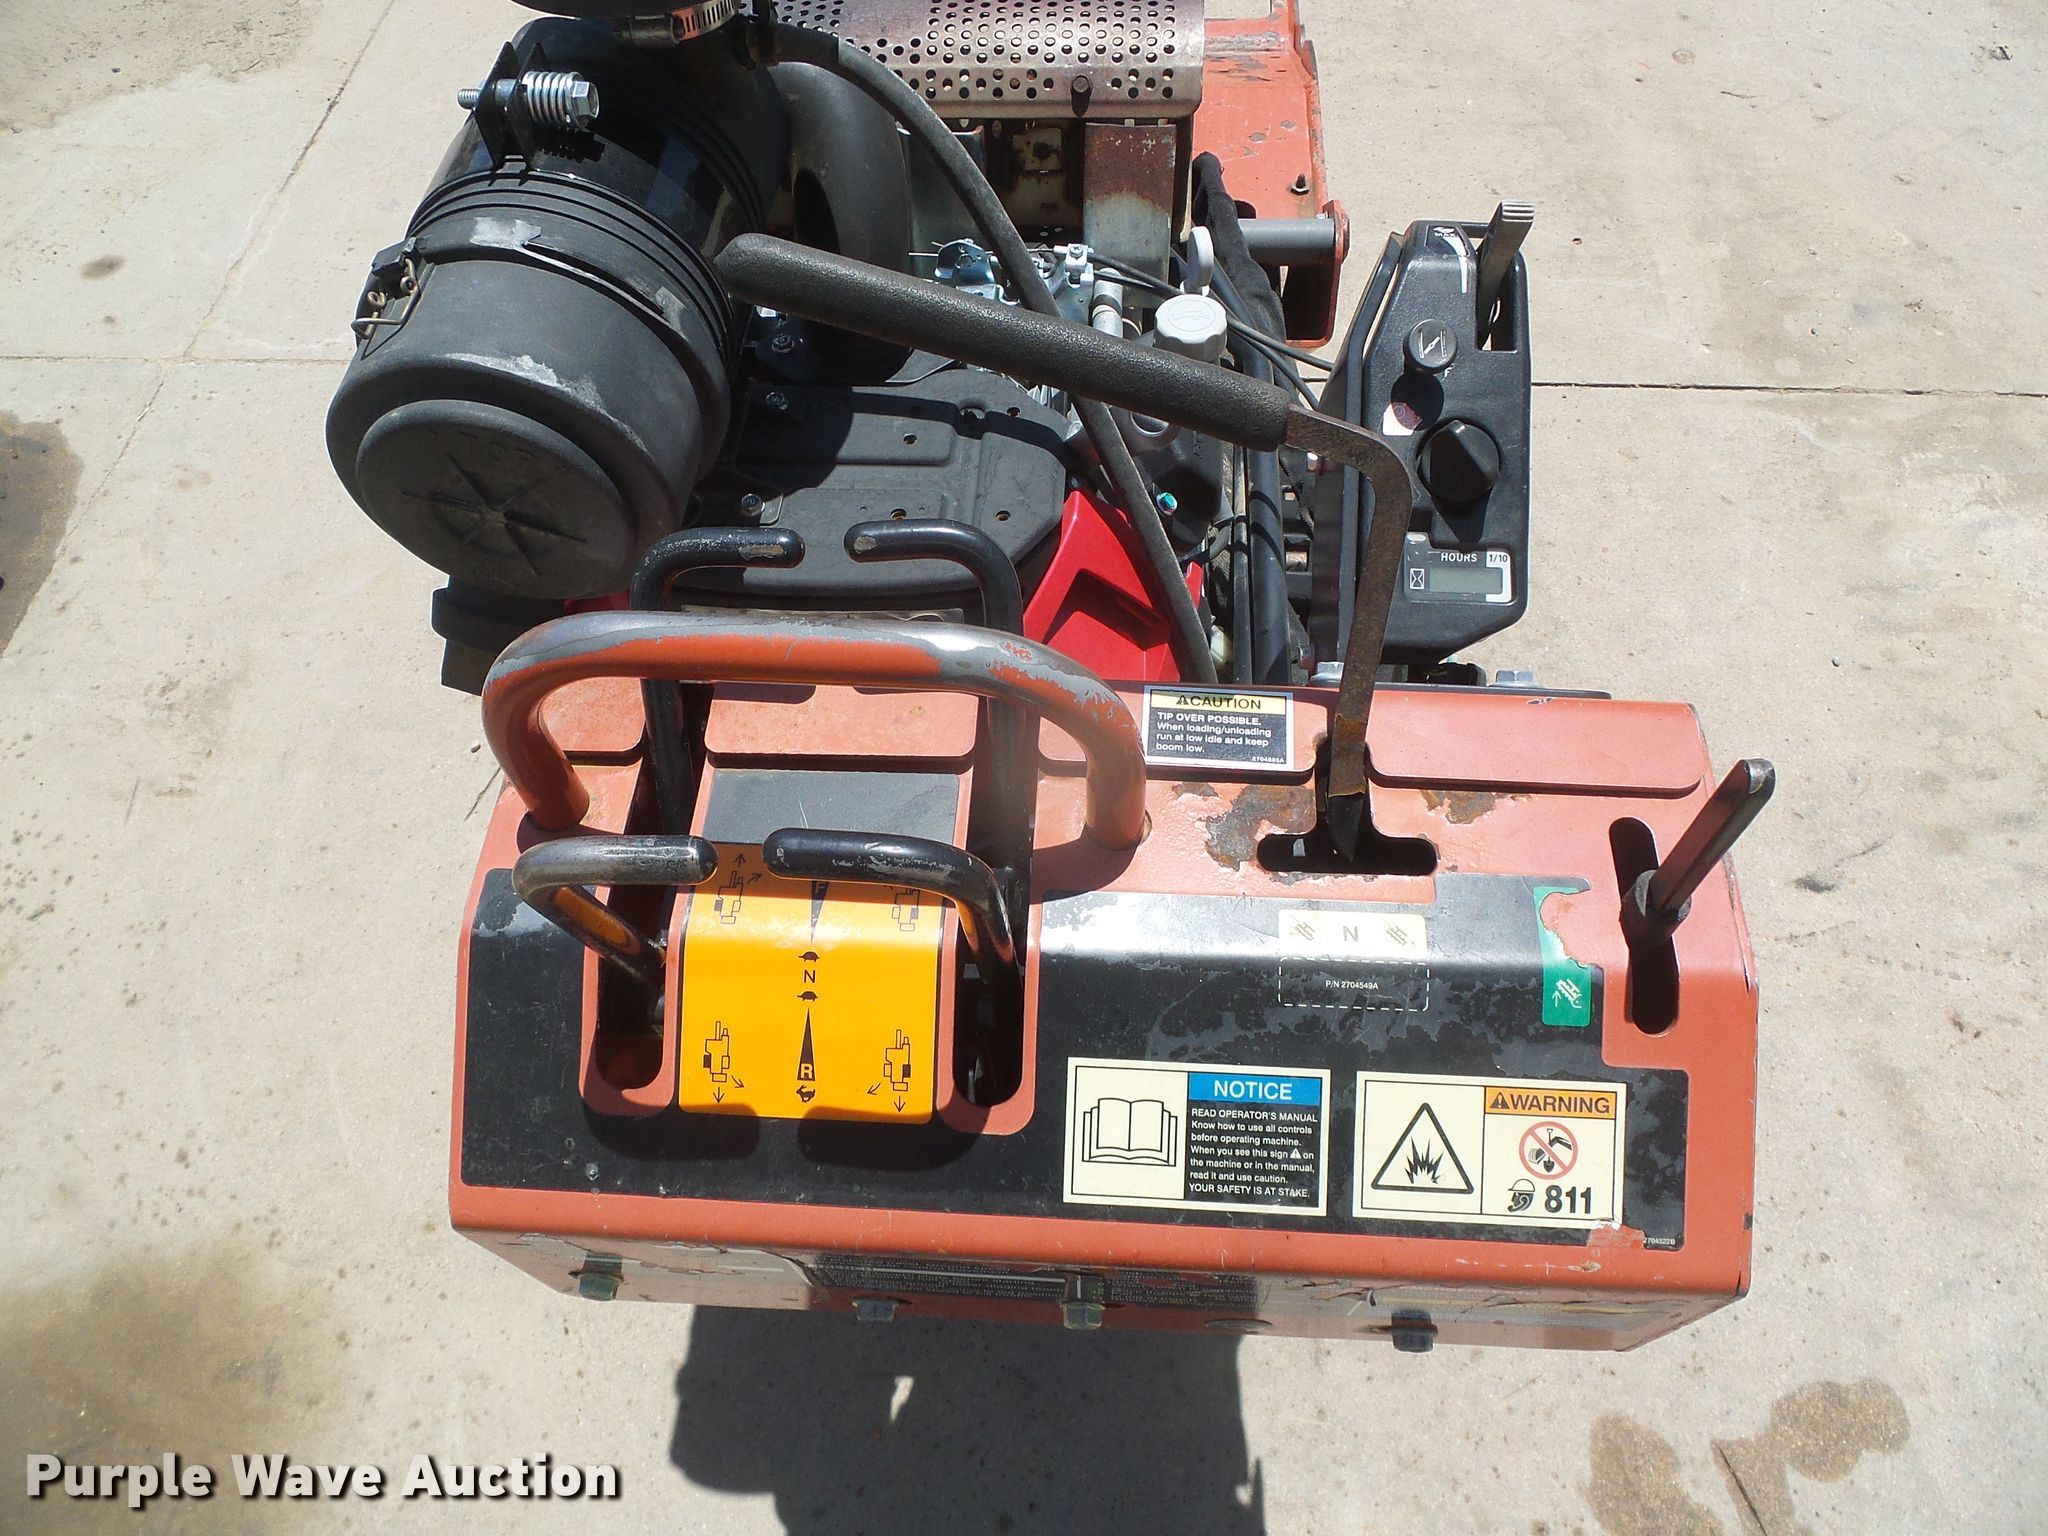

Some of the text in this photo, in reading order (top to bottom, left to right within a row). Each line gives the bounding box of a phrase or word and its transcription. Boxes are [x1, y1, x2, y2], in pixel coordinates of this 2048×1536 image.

[1440, 552, 1508, 563] HOURS 1/10
[1190, 695, 1261, 710] CAUTION
[1158, 712, 1262, 726] TIP OVER POSSIBLE.
[1157, 722, 1272, 737] When loading/unloading
[1156, 733, 1270, 748] run at low idle and keep
[1156, 742, 1205, 753] boom low.
[1344, 925, 1359, 942] N
[803, 970, 816, 984] N
[1325, 980, 1379, 990] P/N 2704549A
[800, 1063, 814, 1078] R
[1214, 1080, 1293, 1100] NOTICE
[1510, 1093, 1611, 1114] WARNING
[1191, 1108, 1318, 1123] READ OPERATOR'S MANUAL
[1191, 1120, 1312, 1134] Know how to use all controls
[1191, 1133, 1302, 1146] before operating machine.
[1190, 1146, 1215, 1156] When
[1216, 1148, 1233, 1157] you
[1252, 1148, 1268, 1157] this
[1270, 1150, 1288, 1160] sign
[1302, 1152, 1314, 1160] on
[1190, 1158, 1204, 1166] the
[1206, 1158, 1242, 1168] machine
[1254, 1161, 1263, 1170] in
[1265, 1162, 1279, 1170] the
[1280, 1164, 1315, 1174] manual,
[1190, 1170, 1288, 1184] read it and use caution.
[1188, 1182, 1310, 1198] YOUR SAFETY IS AT STAKE.
[1544, 1184, 1592, 1215] 811
